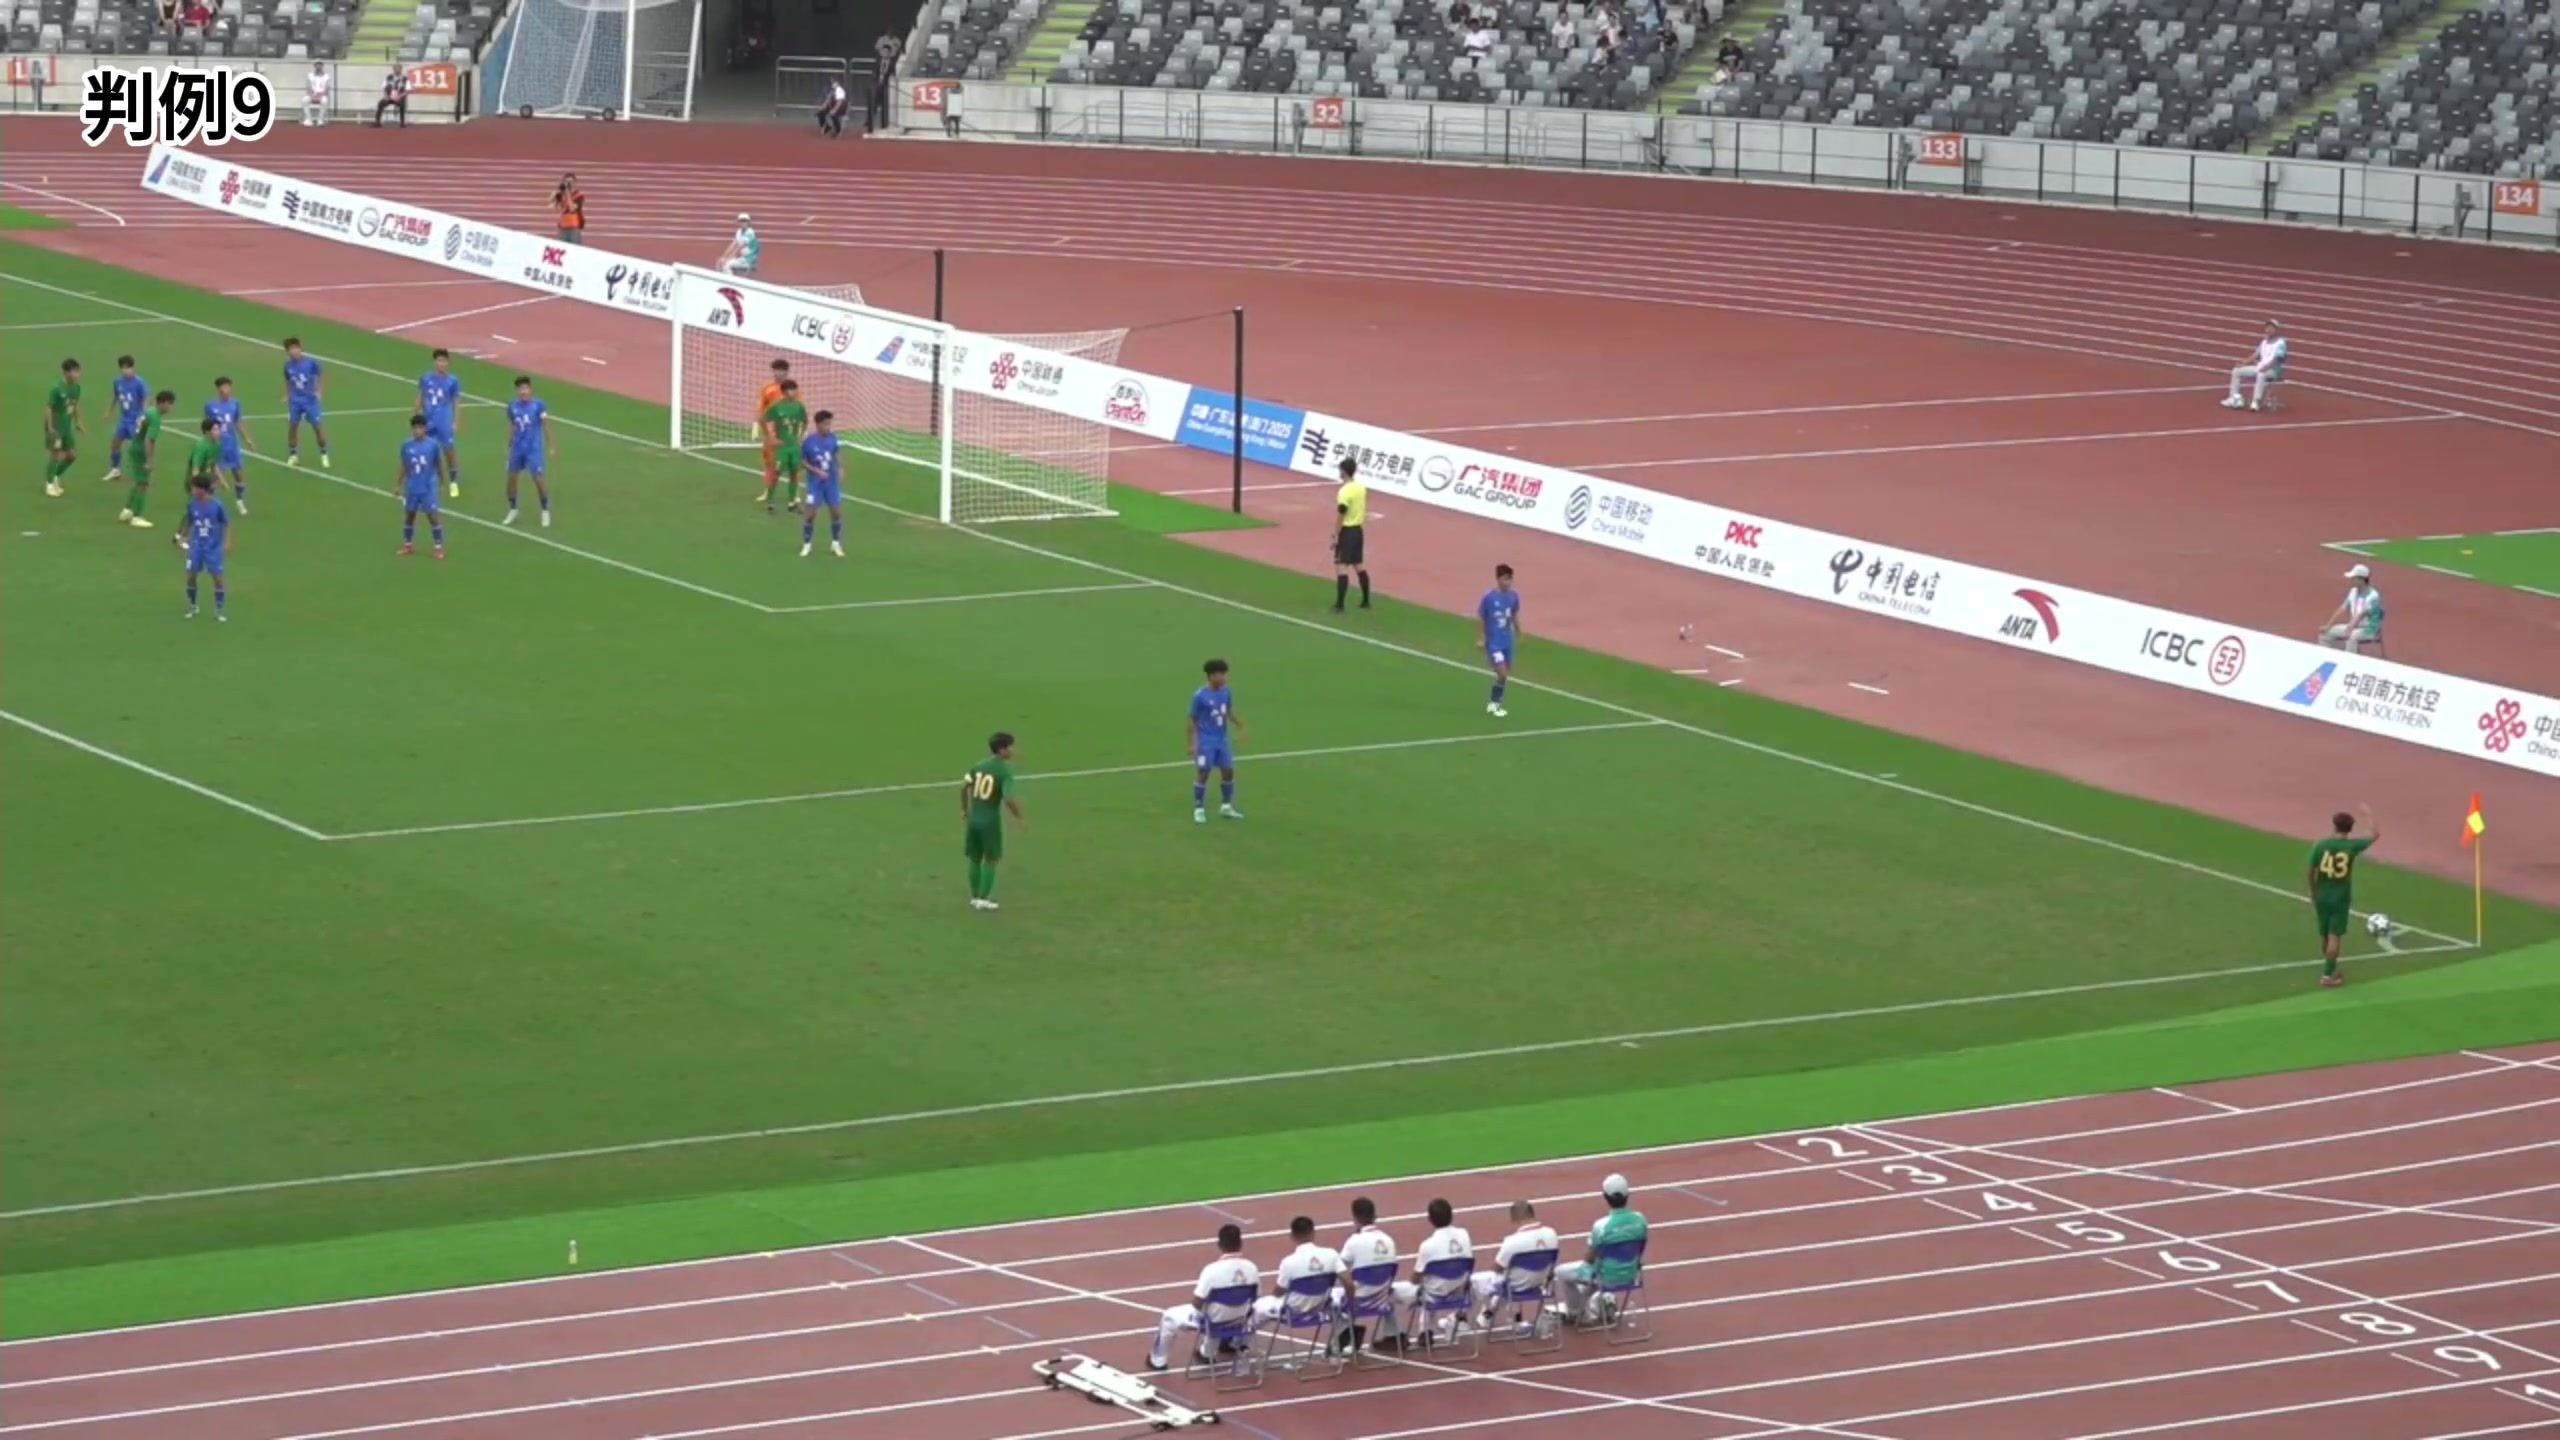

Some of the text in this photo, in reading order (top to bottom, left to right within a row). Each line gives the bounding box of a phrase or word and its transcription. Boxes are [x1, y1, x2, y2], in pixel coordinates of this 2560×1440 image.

[411, 69, 448, 89] 131
[1922, 139, 1957, 160] 133
[2498, 185, 2534, 208] 134
[792, 313, 831, 341] ICBC
[1458, 464, 1543, 497] 广汽集团
[1454, 482, 1537, 510] GAC GROUP
[1725, 521, 1763, 548] PICC
[1999, 614, 2038, 641] ANTA
[2140, 627, 2204, 667] ICBC
[2343, 672, 2441, 713] 中国南方航空
[2335, 695, 2433, 729] CHINA SOUTHERN
[973, 772, 994, 800] 10
[2319, 851, 2349, 878] 43
[1797, 1137, 1869, 1157] 2
[1882, 1164, 1948, 1184] 3
[1982, 1191, 2037, 1212] 4
[2056, 1221, 2126, 1242] 5
[2158, 1250, 2221, 1271] 6
[2233, 1280, 2300, 1303] 7
[2339, 1311, 2416, 1335] 8
[2433, 1345, 2501, 1370] 9
